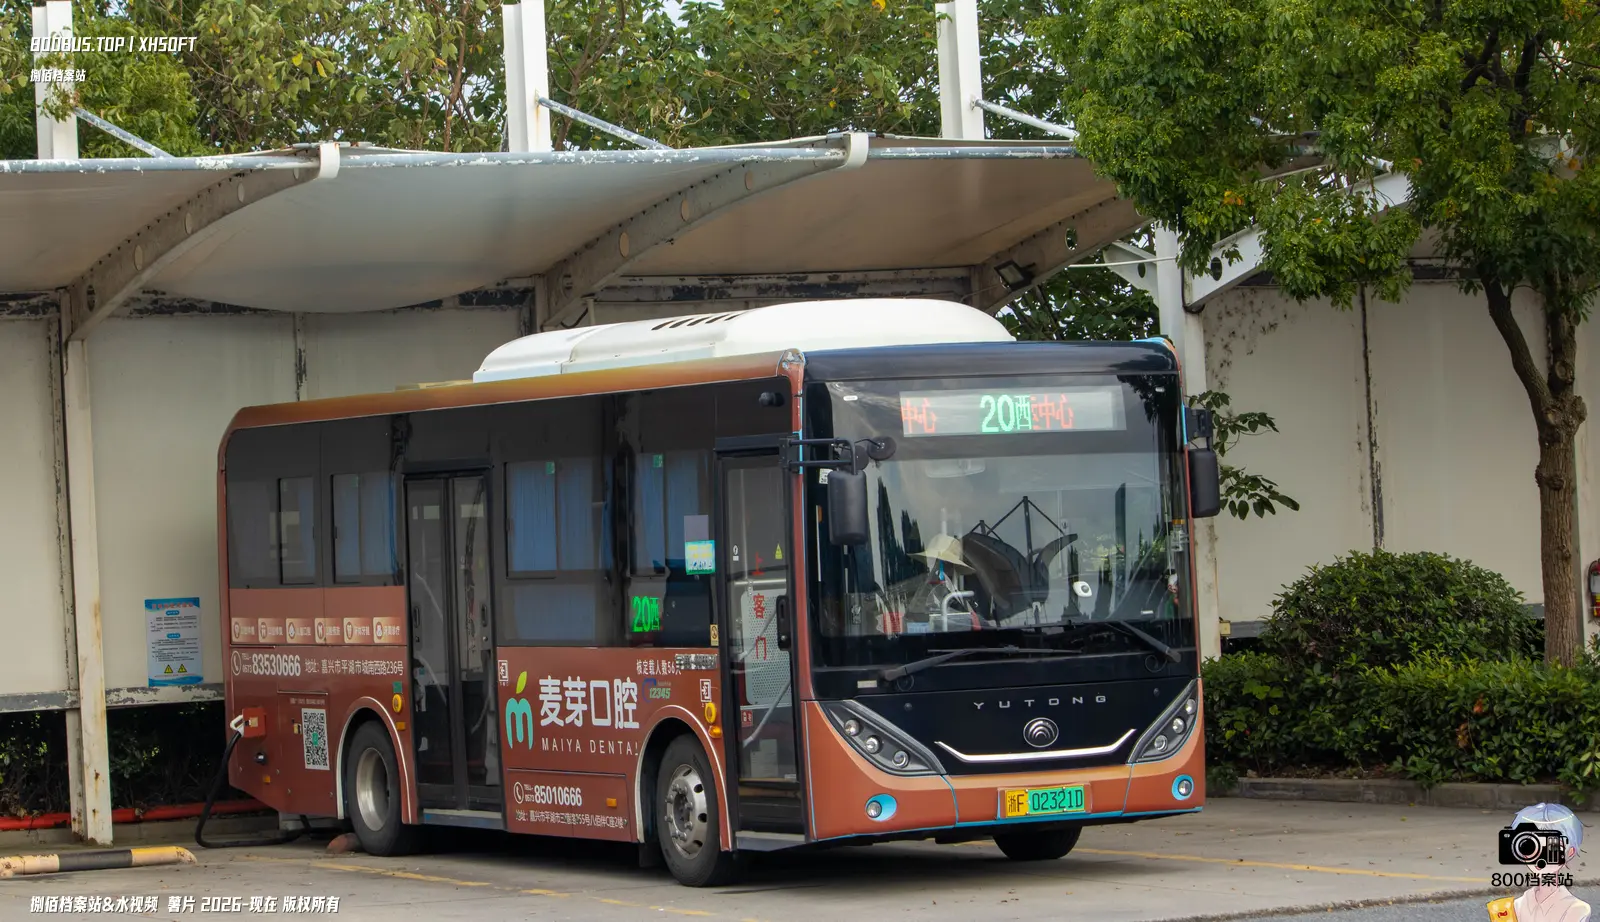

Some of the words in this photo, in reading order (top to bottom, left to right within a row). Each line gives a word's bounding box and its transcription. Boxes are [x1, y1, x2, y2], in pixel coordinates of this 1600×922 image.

[252, 653, 301, 676] 83530666
[649, 687, 671, 698] 12345
[538, 675, 640, 729] 麦芽口腔
[973, 695, 1107, 709] YUTONG
[541, 737, 582, 753] MAIYA
[534, 785, 582, 806] 85010666
